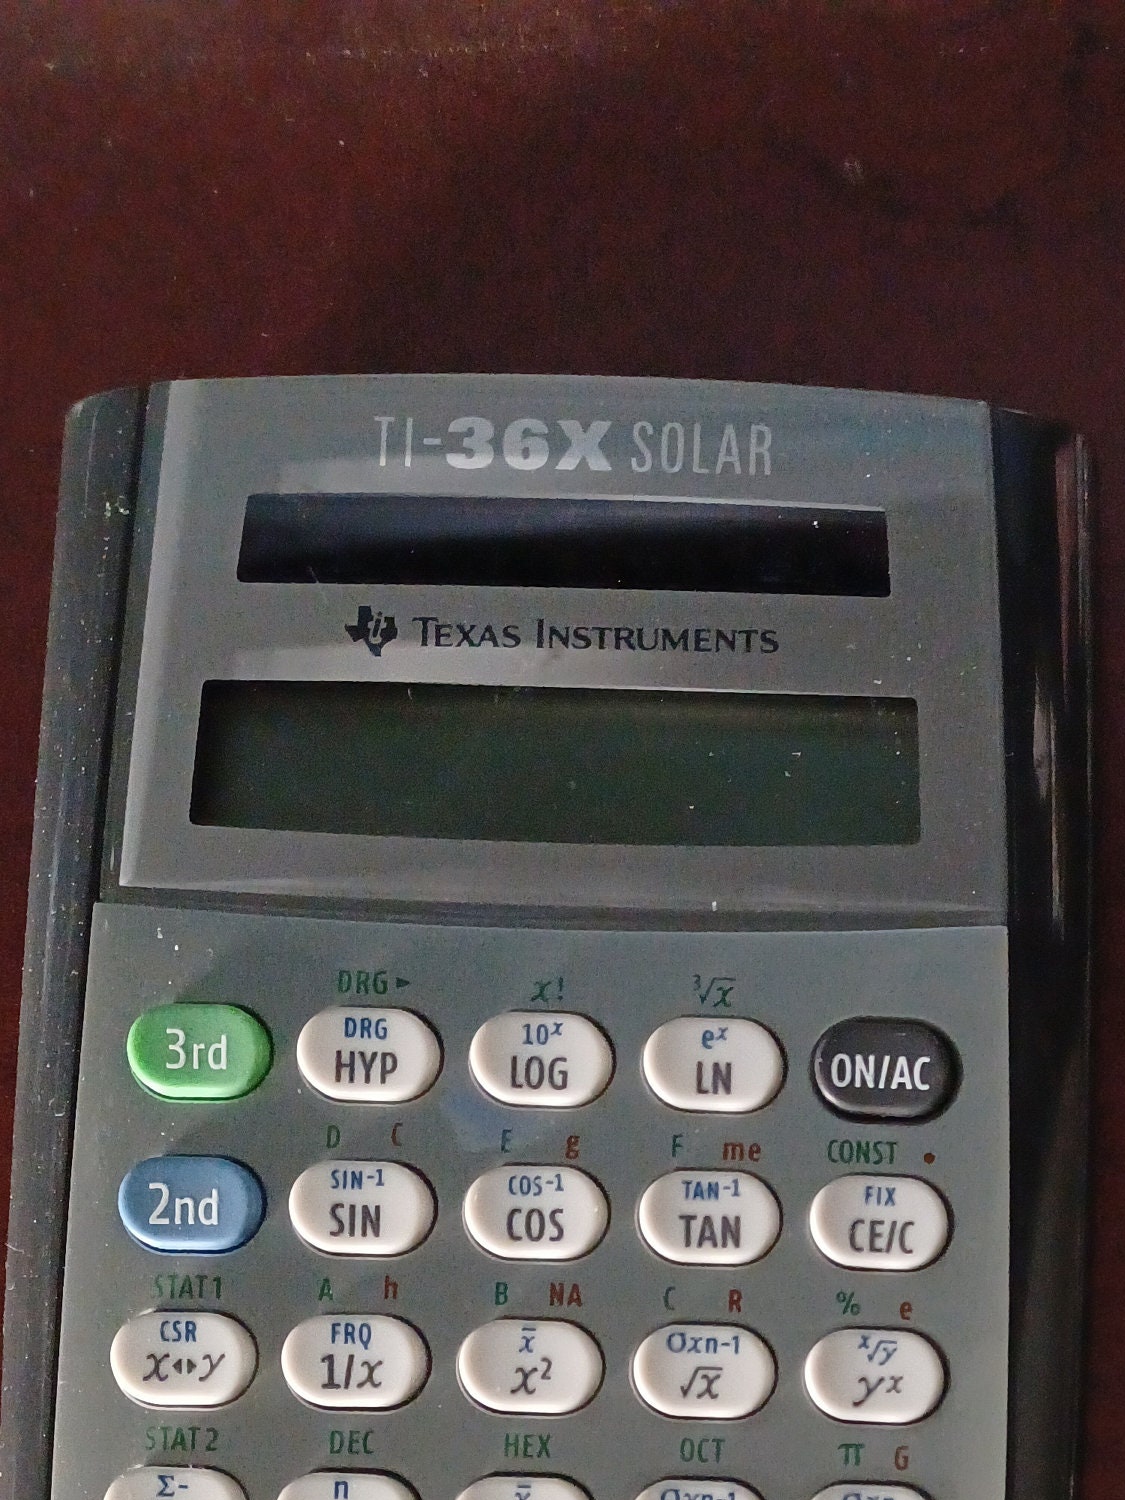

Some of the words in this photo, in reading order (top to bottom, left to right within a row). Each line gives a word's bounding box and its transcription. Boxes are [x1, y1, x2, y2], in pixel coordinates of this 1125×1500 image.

[375, 415, 610, 470] TI-36X
[631, 421, 772, 475] SOLAR
[337, 970, 389, 995] DRG
[343, 1019, 389, 1041] DRG
[164, 1028, 228, 1071] 3rd
[335, 1052, 398, 1084] HYP
[510, 1059, 569, 1090] LOG
[697, 1064, 733, 1094] LN
[830, 1055, 931, 1090] ON/AC
[828, 1139, 898, 1164] CONST
[147, 1183, 218, 1226] 2nd
[864, 1186, 897, 1206] FIX
[329, 1205, 380, 1238] SIN
[506, 1209, 564, 1242] COS
[680, 1216, 741, 1249] TAN
[848, 1220, 914, 1254] CE/C
[549, 1283, 582, 1307] NA
[160, 1320, 196, 1343] CSR
[331, 1322, 372, 1346] FRQ
[329, 1430, 375, 1454] DEC
[504, 1433, 551, 1458] HEX
[680, 1438, 725, 1463] OCT
